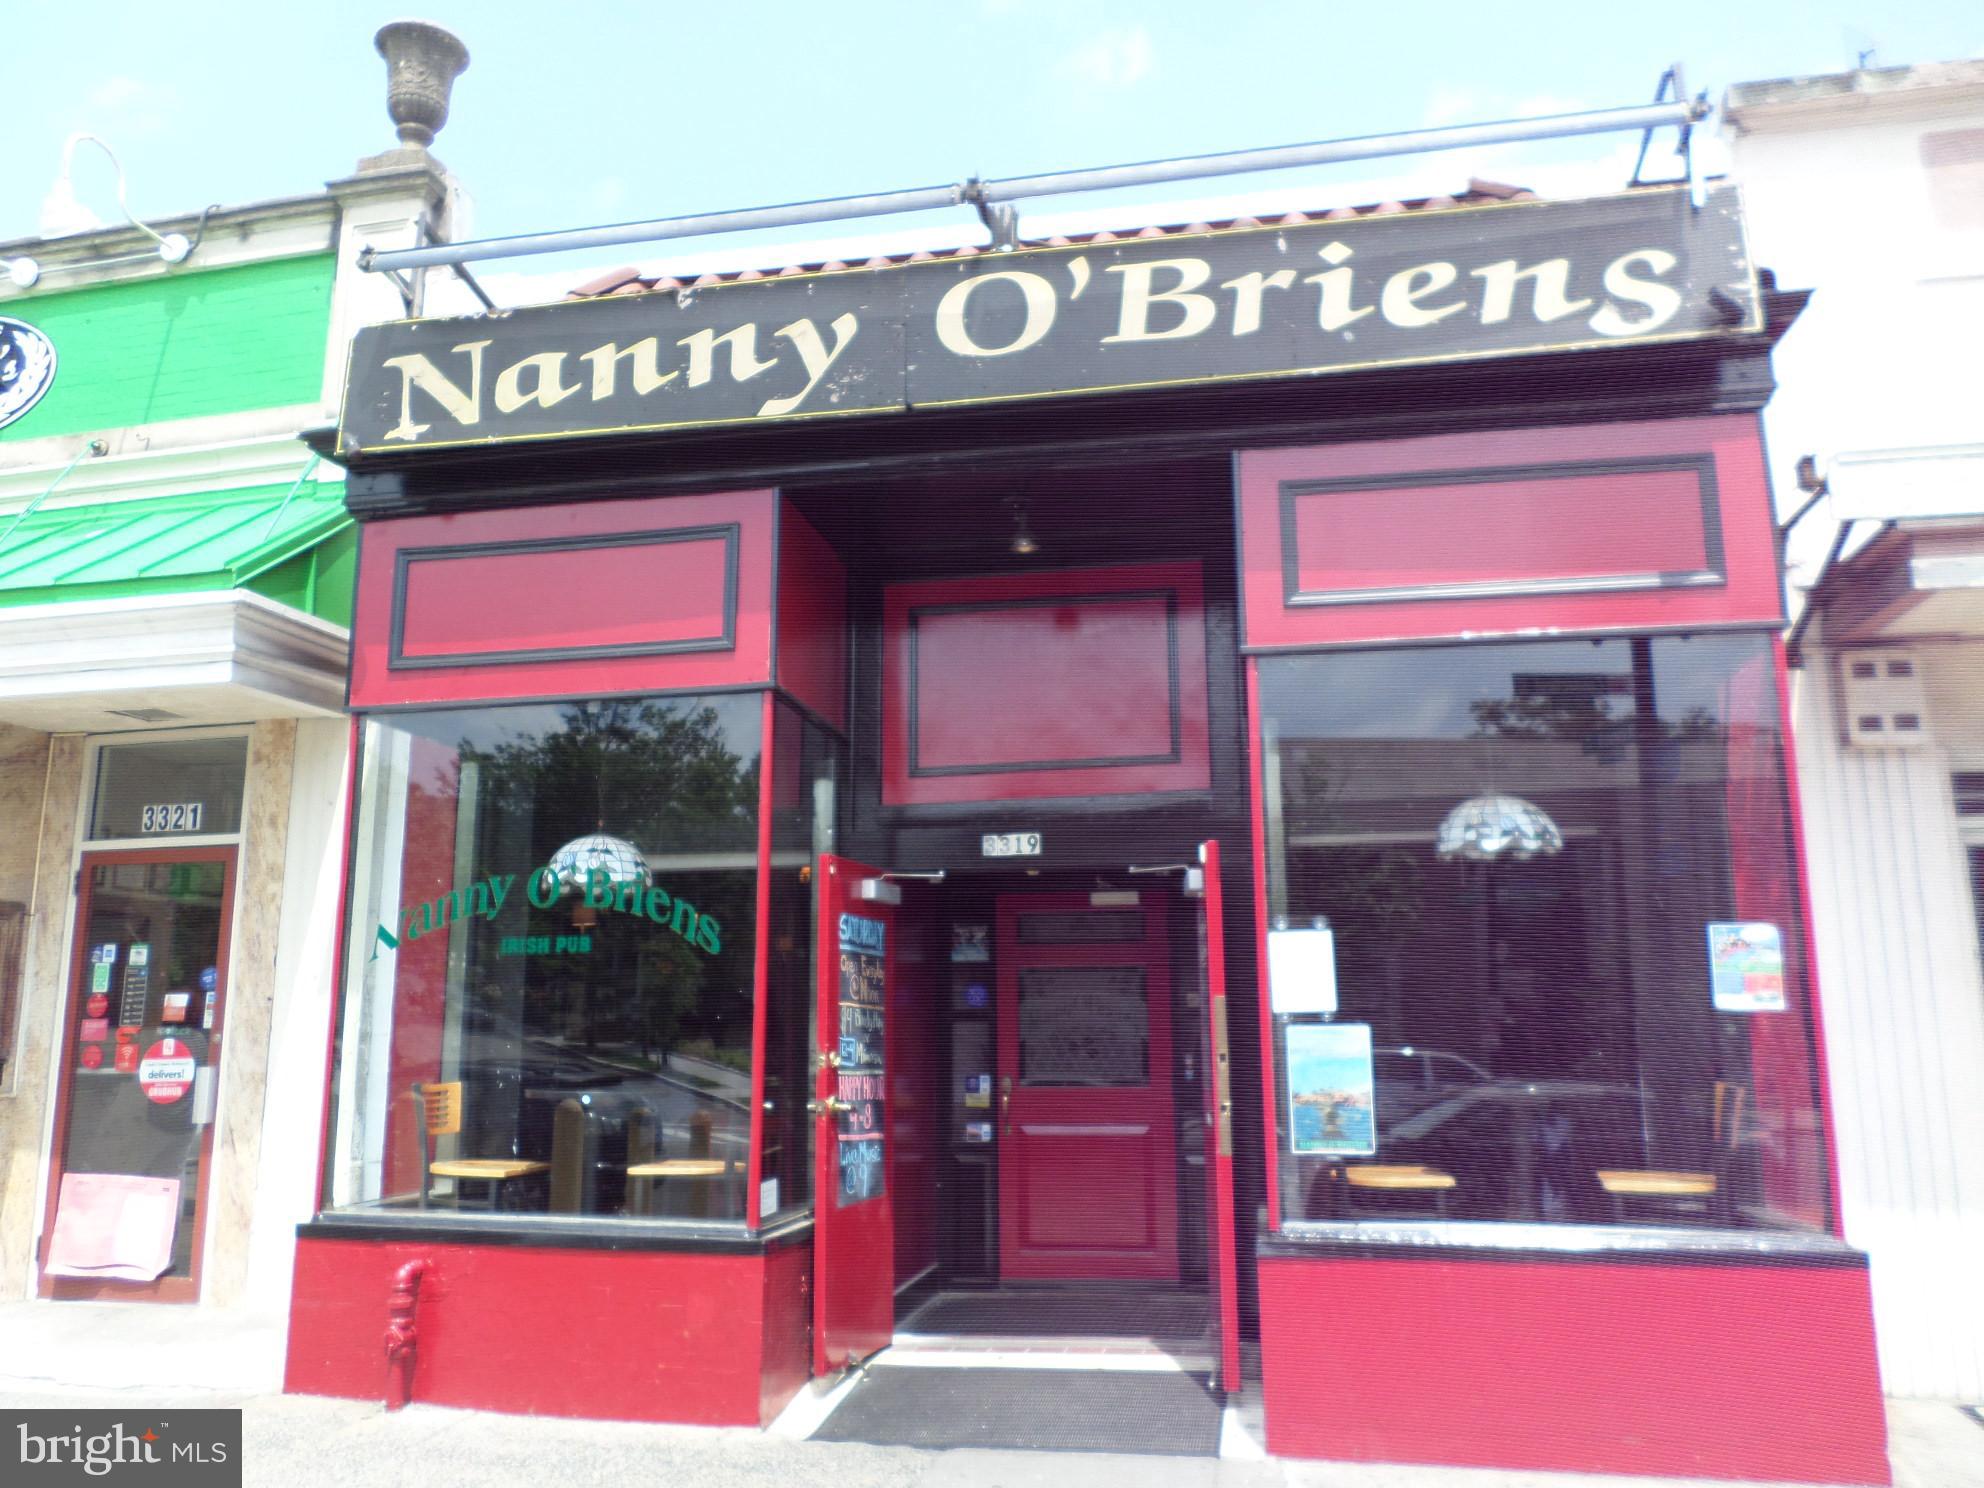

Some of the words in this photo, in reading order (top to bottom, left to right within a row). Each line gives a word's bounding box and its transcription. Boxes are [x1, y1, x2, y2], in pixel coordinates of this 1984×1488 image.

[383, 311, 858, 440] Nanny
[936, 240, 1681, 358] O'Briens
[144, 804, 198, 831] 3321
[527, 864, 722, 957] O'Briens
[499, 935, 549, 957] IRISH
[555, 934, 593, 955] PUB
[147, 1068, 185, 1081] delivers!
[839, 1076, 862, 1101] HAPPY
